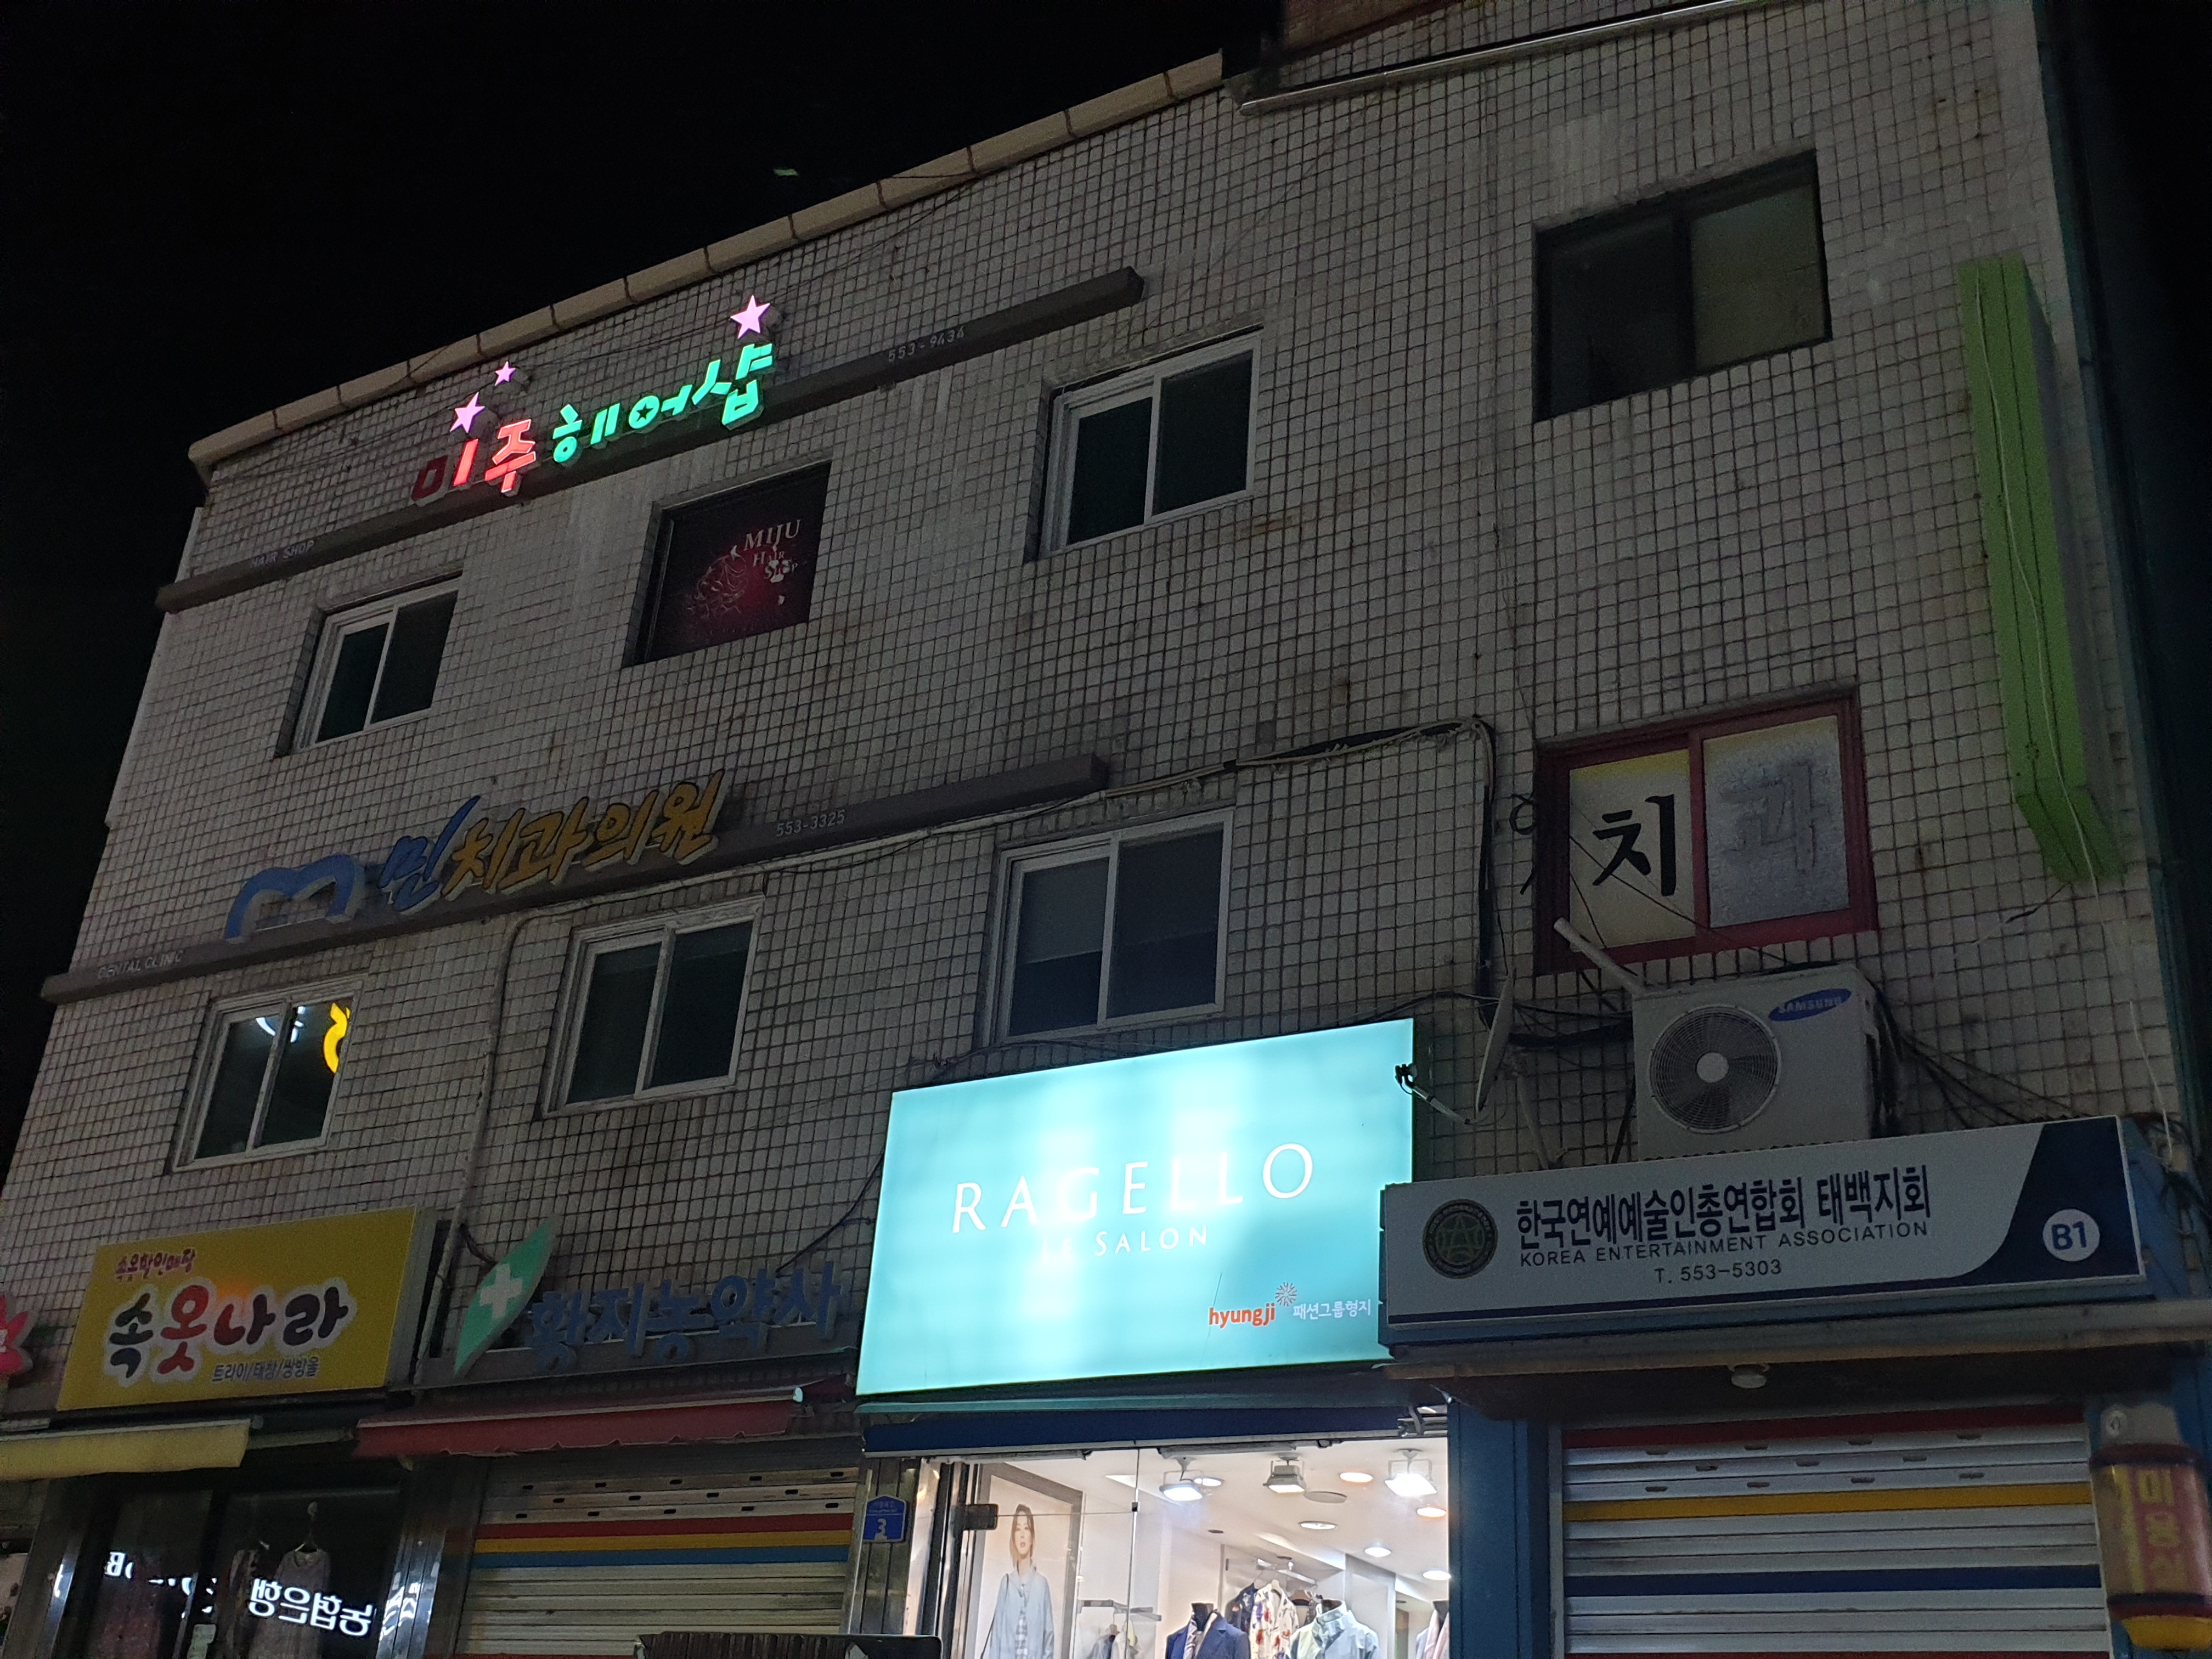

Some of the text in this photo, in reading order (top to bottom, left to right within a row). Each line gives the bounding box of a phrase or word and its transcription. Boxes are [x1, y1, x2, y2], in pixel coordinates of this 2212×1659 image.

[410, 343, 774, 501] 미주 헤어샵
[743, 519, 802, 551] MIJU
[763, 562, 799, 580] SHP
[776, 809, 845, 837] 553-3325
[145, 950, 185, 970] CLINIC
[1778, 996, 1842, 1014] SAMSUNG
[952, 1143, 1314, 1233] RAGELLO
[1517, 1176, 1805, 1250] 한국연예예술인총연합회
[1816, 1164, 1931, 1226] 태백지회
[1094, 1225, 1208, 1256] SALON
[1520, 1221, 1928, 1267] KOREA ENTERTAINMENT ASSOCIATION
[2052, 1221, 2087, 1250] B1
[1654, 1259, 1782, 1284] T. 553-5303
[525, 1261, 841, 1373] 황지농약사
[1209, 1302, 1276, 1329] hyungji
[1293, 1299, 1372, 1320] 패션그룹형지
[110, 1284, 349, 1379] 속옷나라
